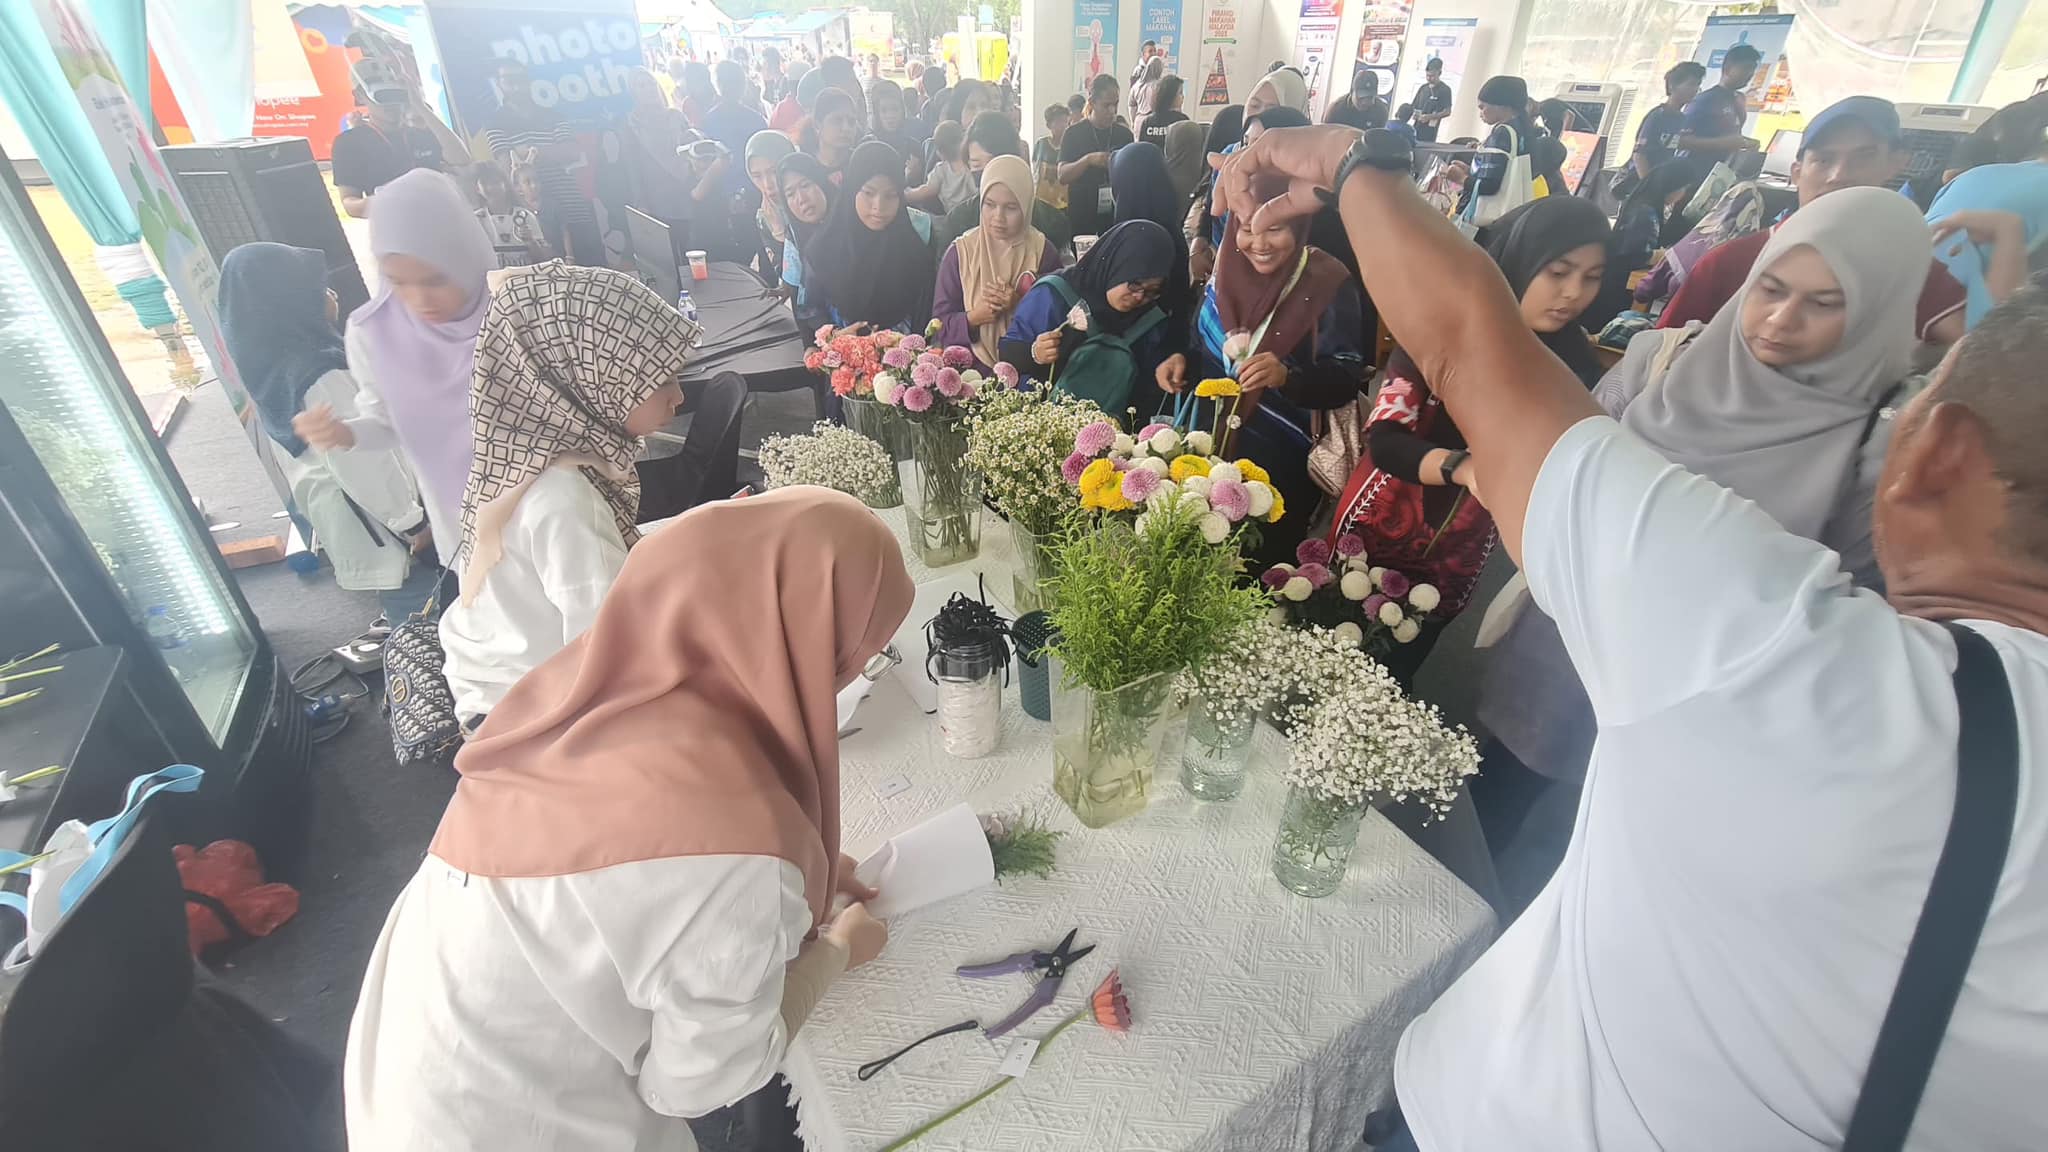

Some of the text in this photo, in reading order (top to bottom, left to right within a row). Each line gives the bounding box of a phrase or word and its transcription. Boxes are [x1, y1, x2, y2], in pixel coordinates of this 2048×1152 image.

[1149, 8, 1175, 17] CONTOH
[1145, 23, 1177, 33] MAKANAN
[488, 58, 631, 108] ooth
